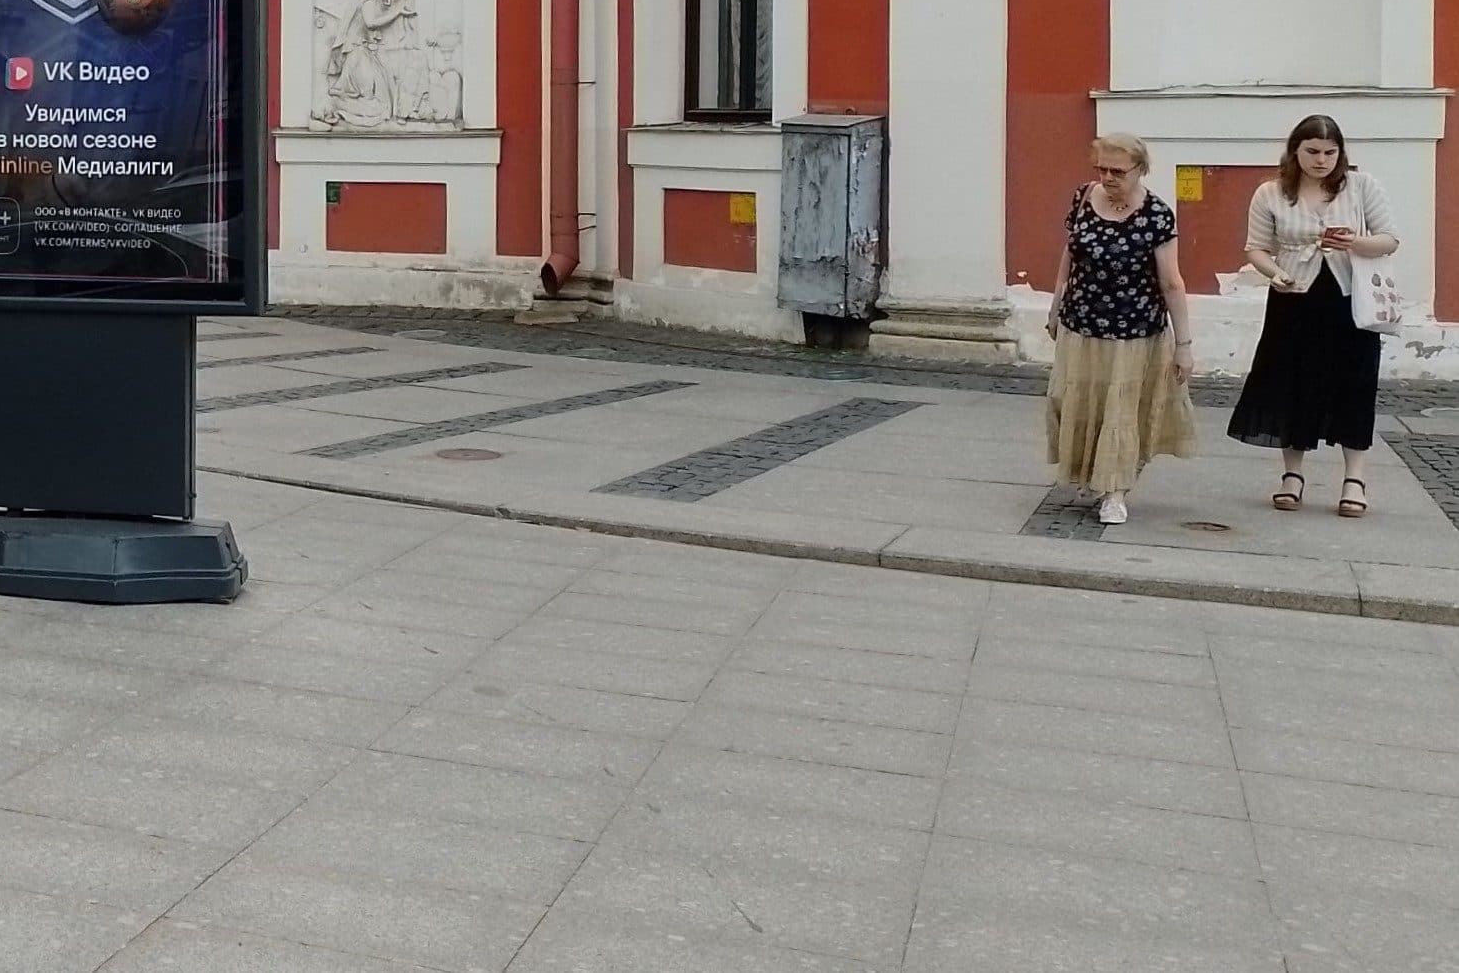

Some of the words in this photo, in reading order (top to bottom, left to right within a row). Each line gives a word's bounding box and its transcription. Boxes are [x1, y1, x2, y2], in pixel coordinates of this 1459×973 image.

[43, 61, 74, 81] VK
[79, 61, 150, 84] Видео
[25, 103, 127, 125] Увидимся
[12, 134, 78, 149] новом
[82, 134, 158, 149] сезоне
[57, 156, 174, 178] Медиалиги
[34, 206, 57, 217] ООО
[132, 208, 145, 218] VK
[147, 208, 182, 219] ВИДЕО
